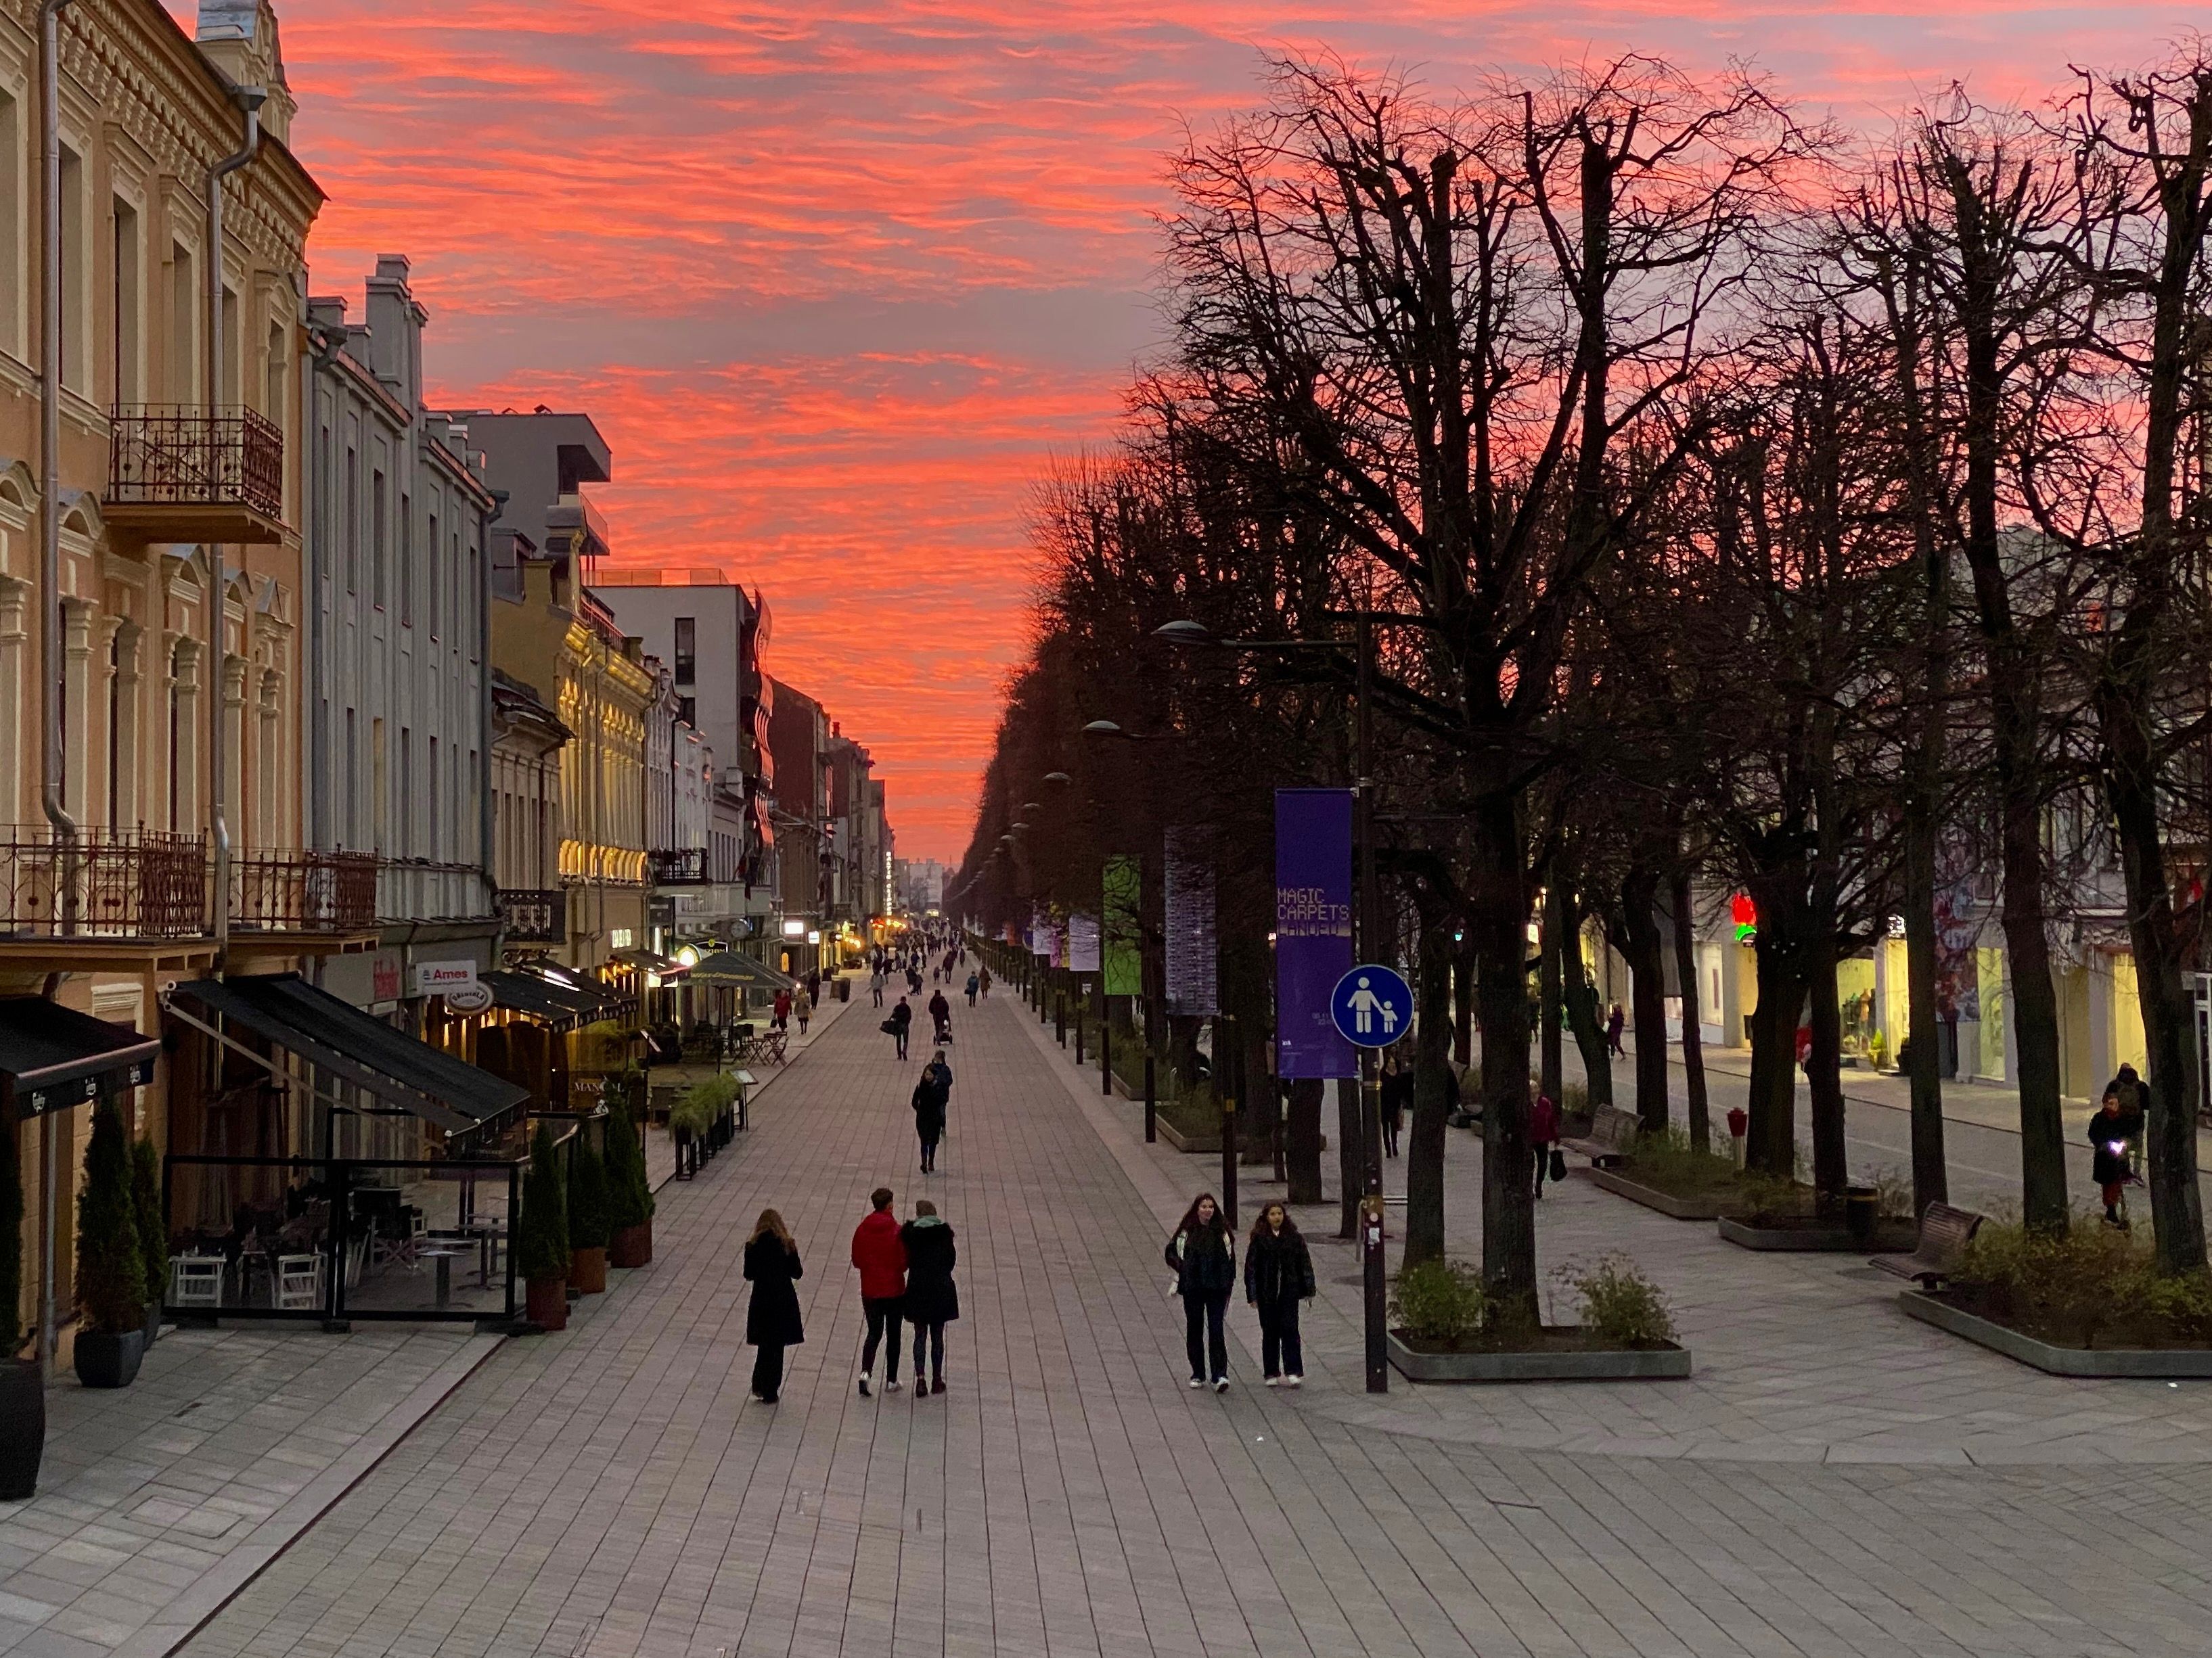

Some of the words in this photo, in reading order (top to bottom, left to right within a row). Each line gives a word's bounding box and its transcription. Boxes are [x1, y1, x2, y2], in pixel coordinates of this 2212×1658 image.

[1278, 888, 1325, 904] MAGIC
[1278, 904, 1350, 921] CARPETS
[433, 969, 468, 980] Ames
